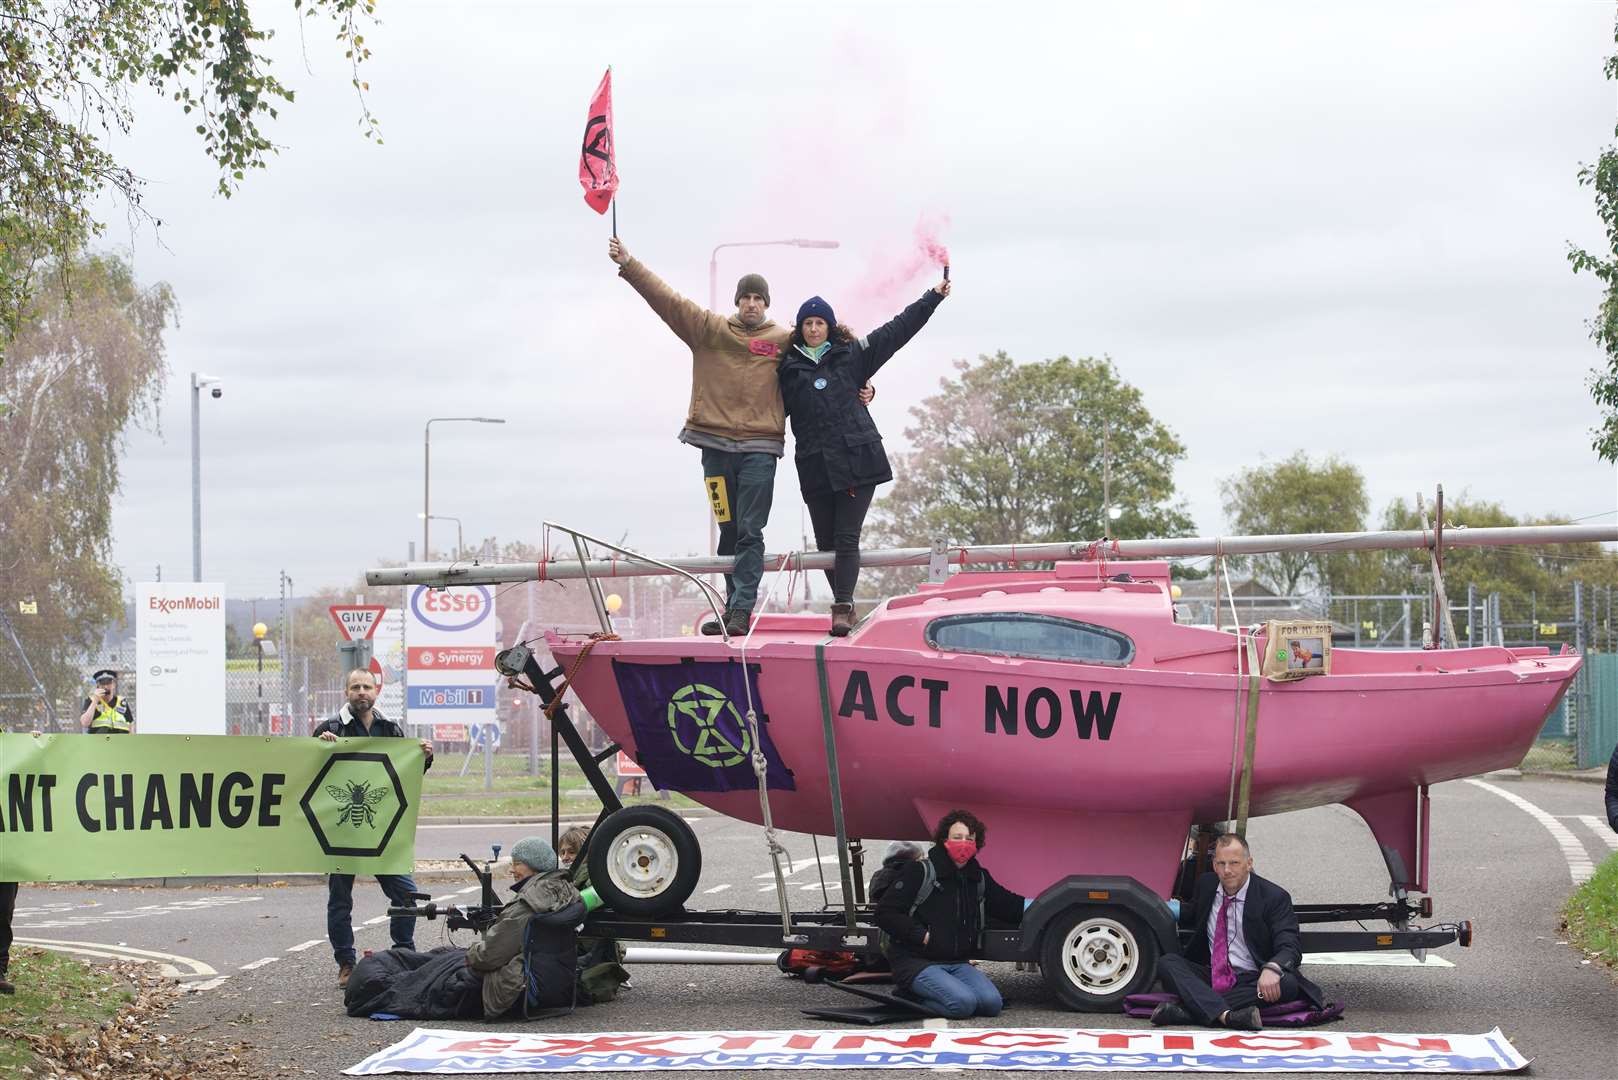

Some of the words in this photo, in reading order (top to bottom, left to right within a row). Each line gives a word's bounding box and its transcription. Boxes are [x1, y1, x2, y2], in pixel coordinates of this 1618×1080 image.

[149, 597, 220, 614] ExxonMobil
[341, 612, 373, 623] GIVE
[1281, 626, 1298, 635] FOR
[438, 651, 484, 665] Synergy
[419, 689, 465, 705] Mobil
[838, 670, 949, 729] ACT
[985, 685, 1122, 741] NOW
[0, 773, 57, 832] NT
[75, 771, 286, 833] CHANGE
[437, 1032, 1452, 1056] EXTINCTION
[865, 1054, 939, 1063] IN
